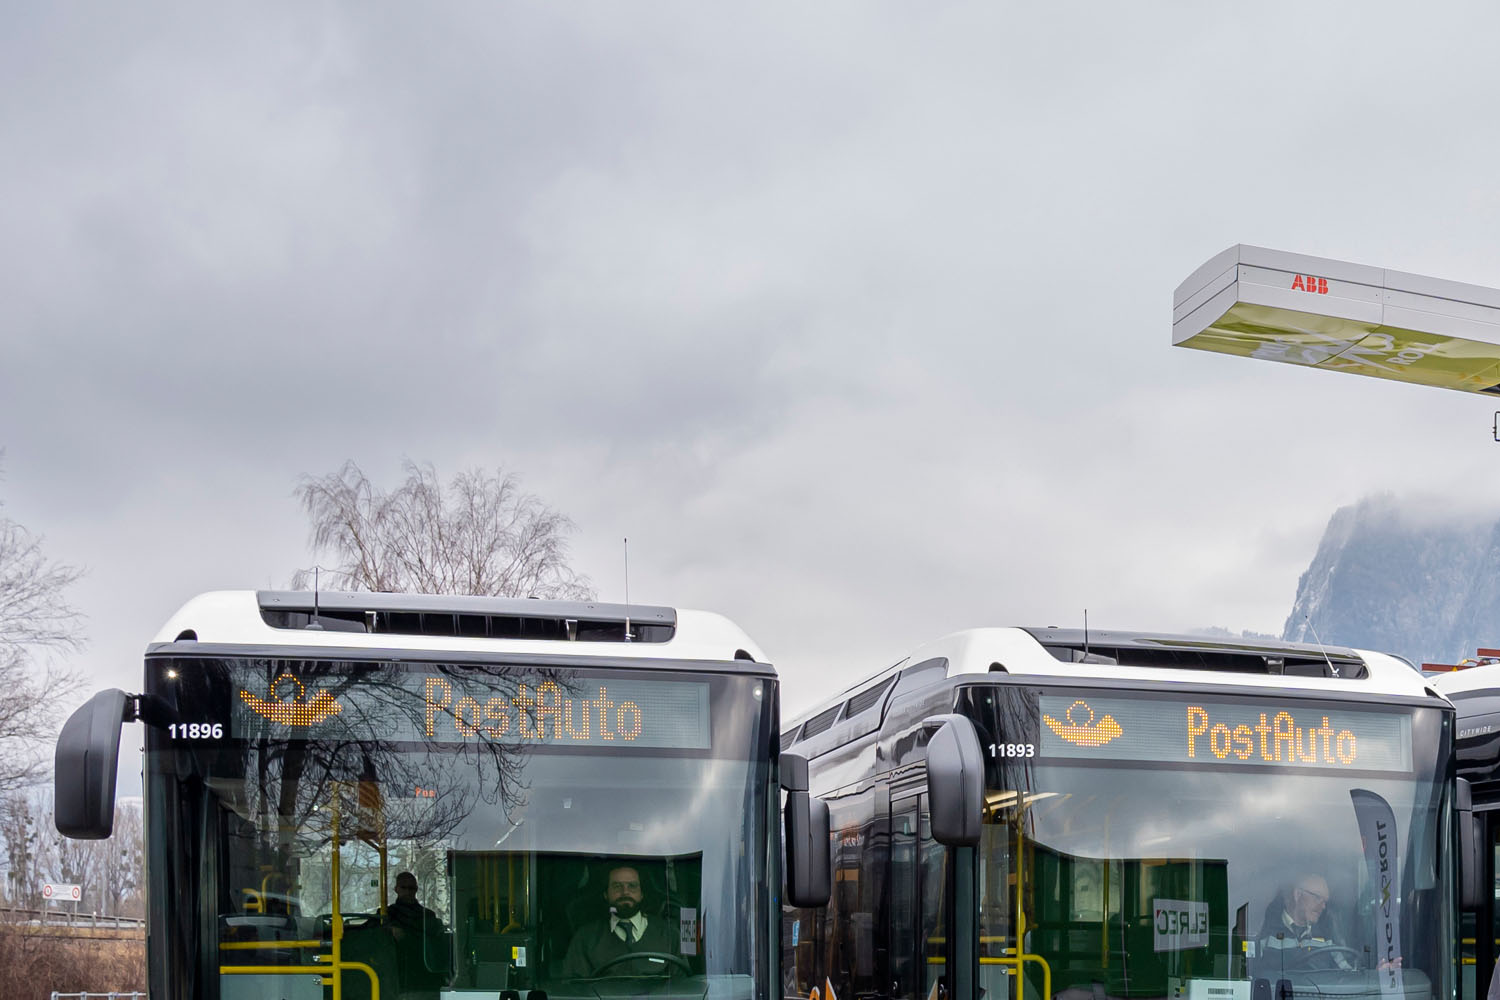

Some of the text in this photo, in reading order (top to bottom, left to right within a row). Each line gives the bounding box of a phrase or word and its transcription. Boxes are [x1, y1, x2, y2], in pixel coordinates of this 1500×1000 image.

[1291, 274, 1329, 295] ABB
[426, 678, 642, 740] PostAuto
[168, 723, 223, 739] 11896
[1187, 706, 1357, 765] PostAuto
[988, 743, 1035, 758] 11893
